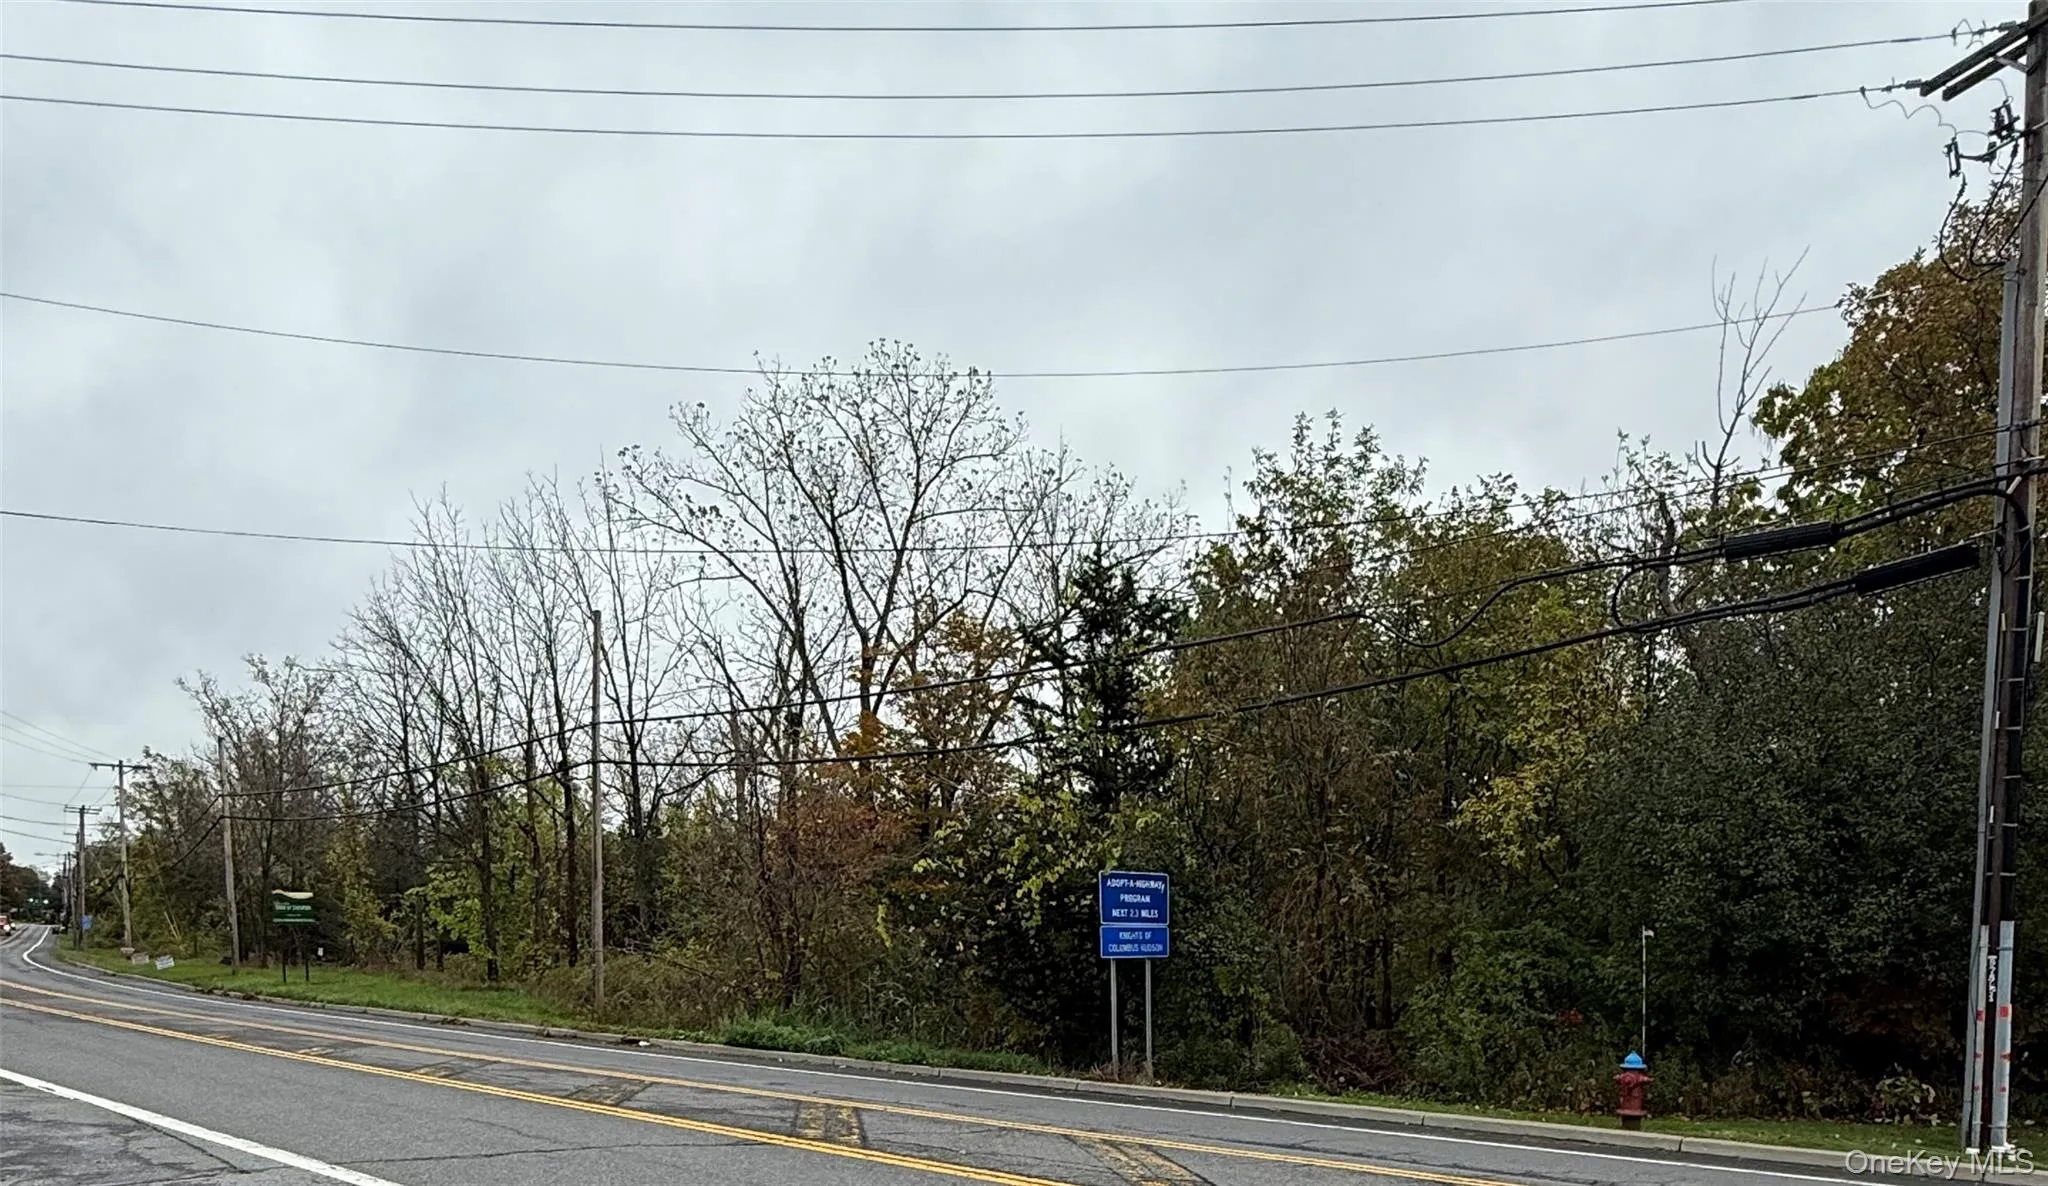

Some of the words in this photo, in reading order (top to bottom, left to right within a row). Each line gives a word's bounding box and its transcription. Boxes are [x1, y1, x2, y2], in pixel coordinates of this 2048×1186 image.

[1106, 878, 1163, 889] ADOPT-A-HIGHWAY
[1120, 894, 1151, 903] PROGRAM
[1112, 908, 1128, 917] NEXT
[1141, 909, 1158, 918] MILES
[1119, 931, 1143, 940] KNIGHTS
[1108, 943, 1139, 952] COLUMBUS
